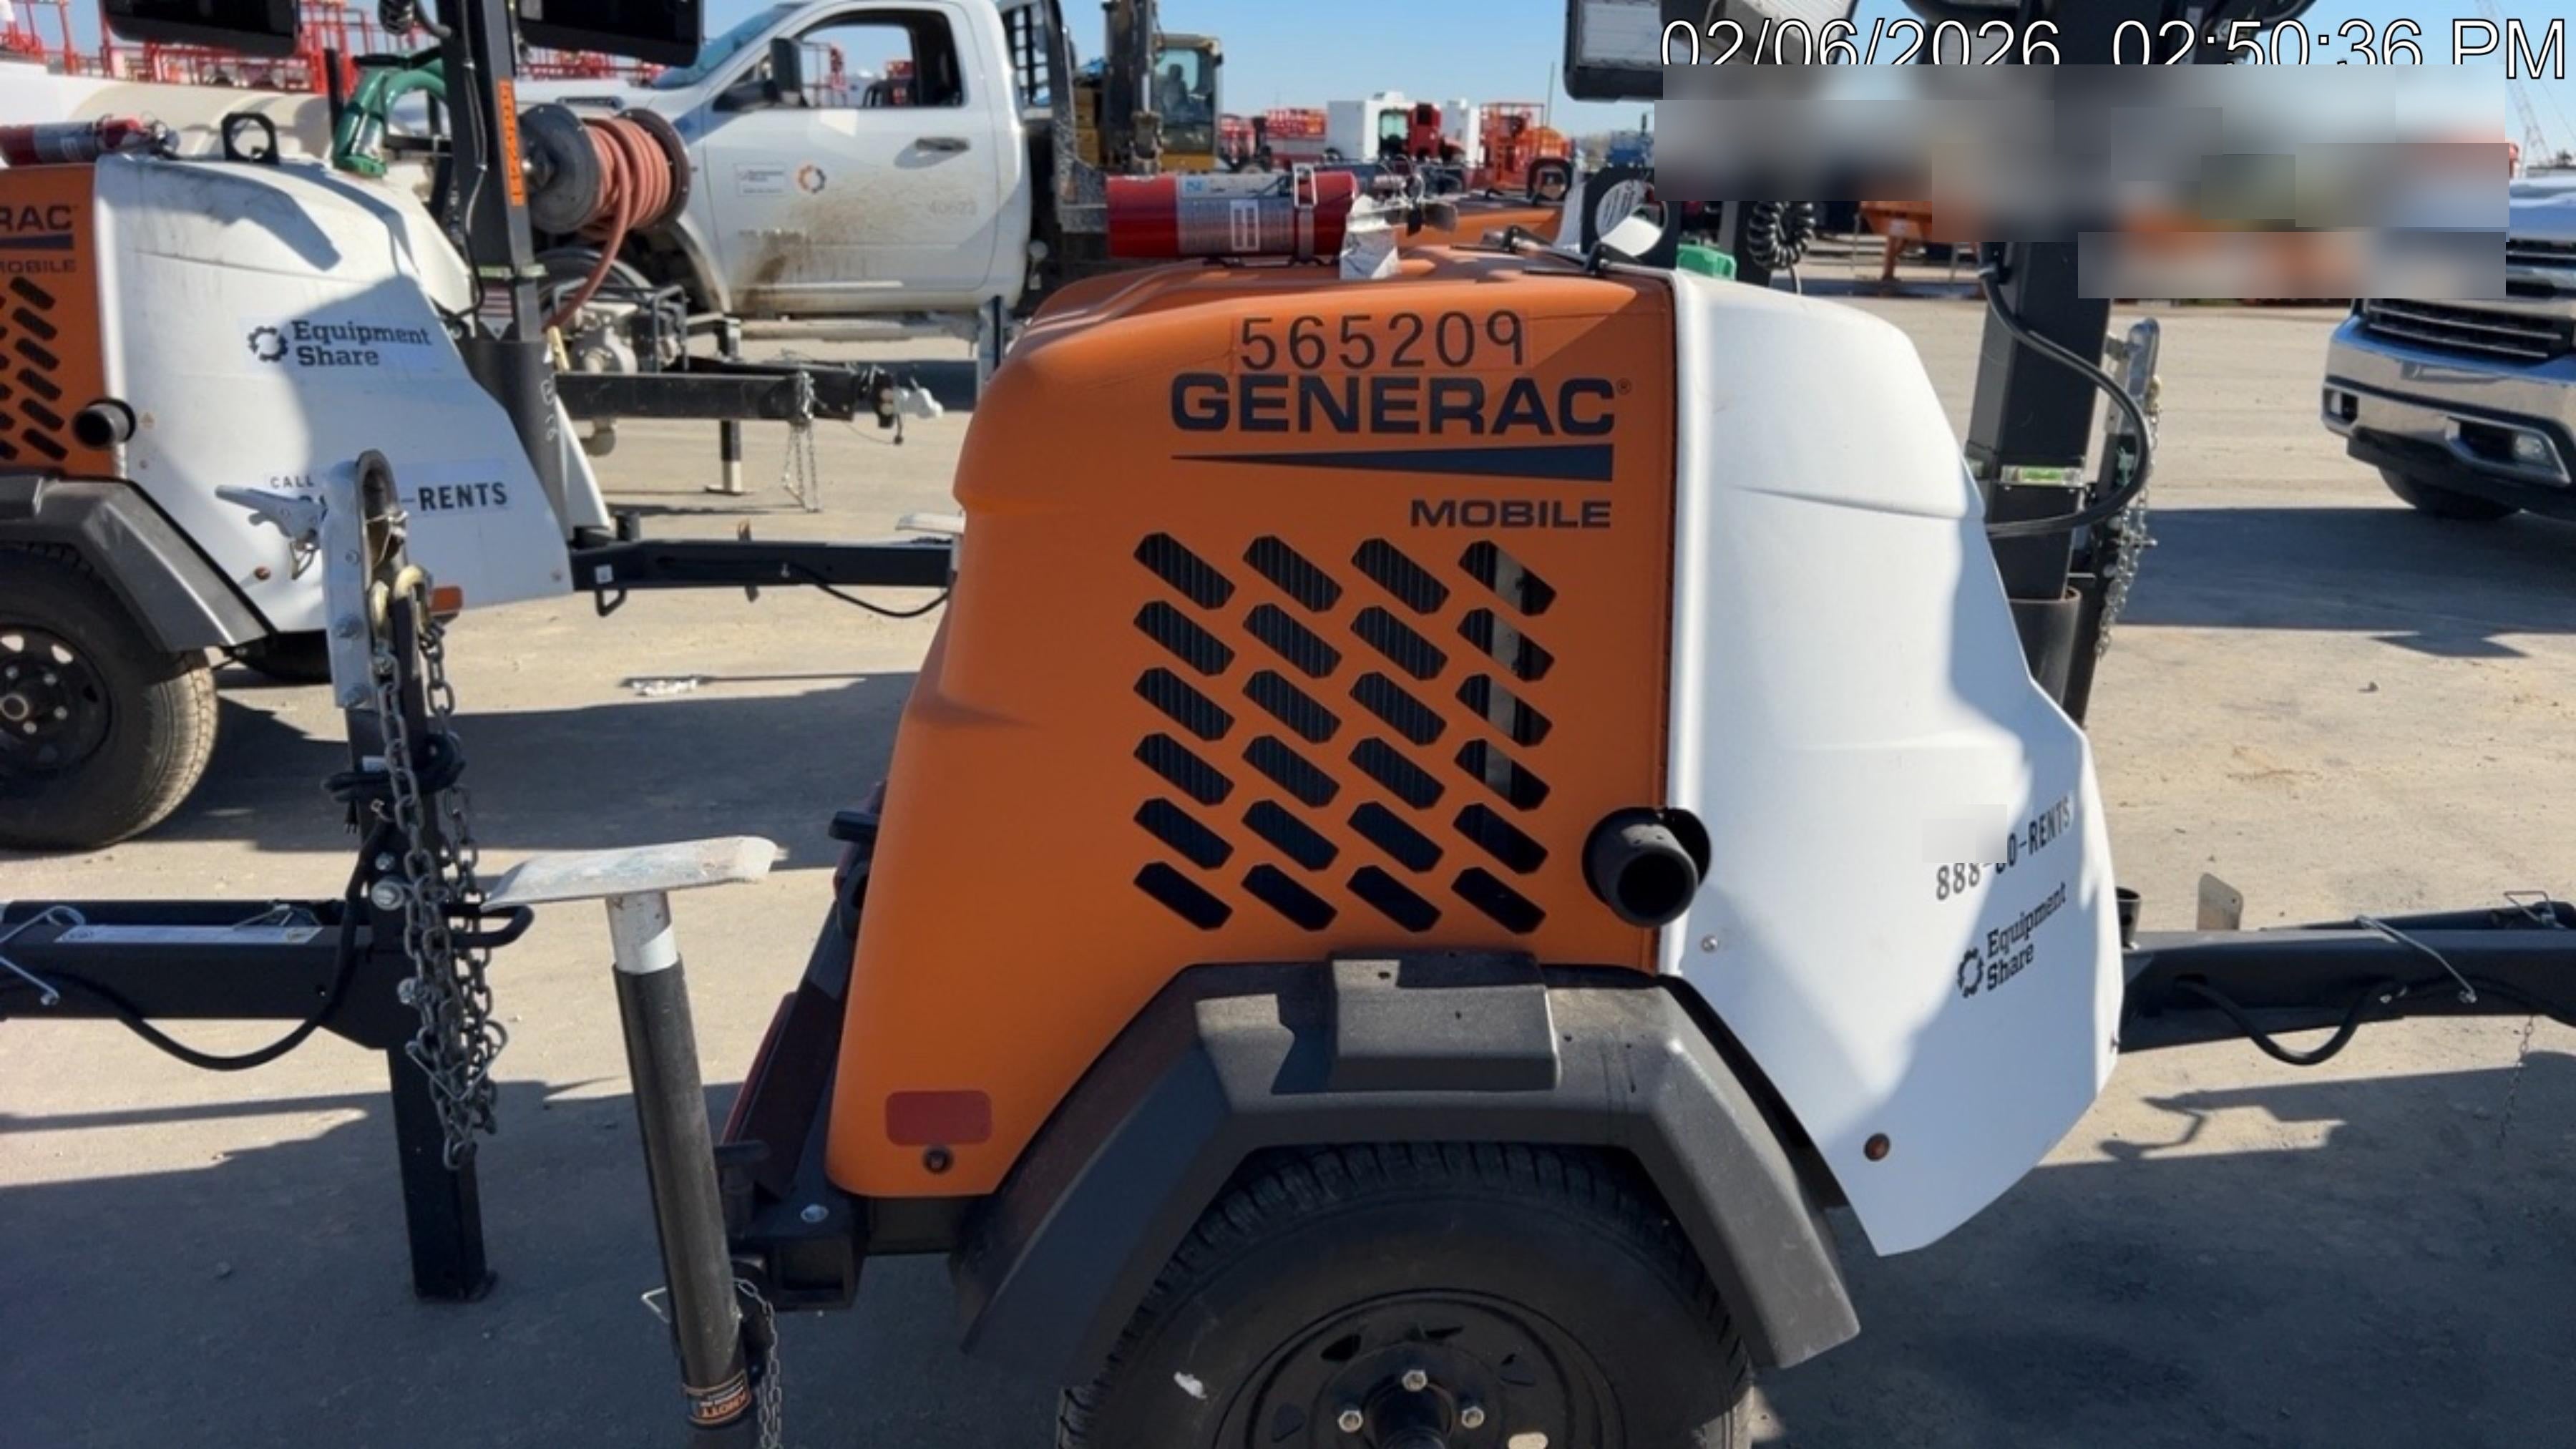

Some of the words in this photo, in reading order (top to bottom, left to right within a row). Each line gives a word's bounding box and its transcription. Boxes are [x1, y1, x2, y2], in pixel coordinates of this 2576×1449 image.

[0, 259, 76, 273] OBILE
[291, 319, 433, 346] Equipment
[1239, 310, 1524, 371] 565209
[296, 346, 379, 366] Share
[270, 475, 314, 488] CALL
[1410, 499, 1611, 529] MOBILE
[1986, 881, 2067, 958] Equipment
[1987, 942, 2034, 991] Share
